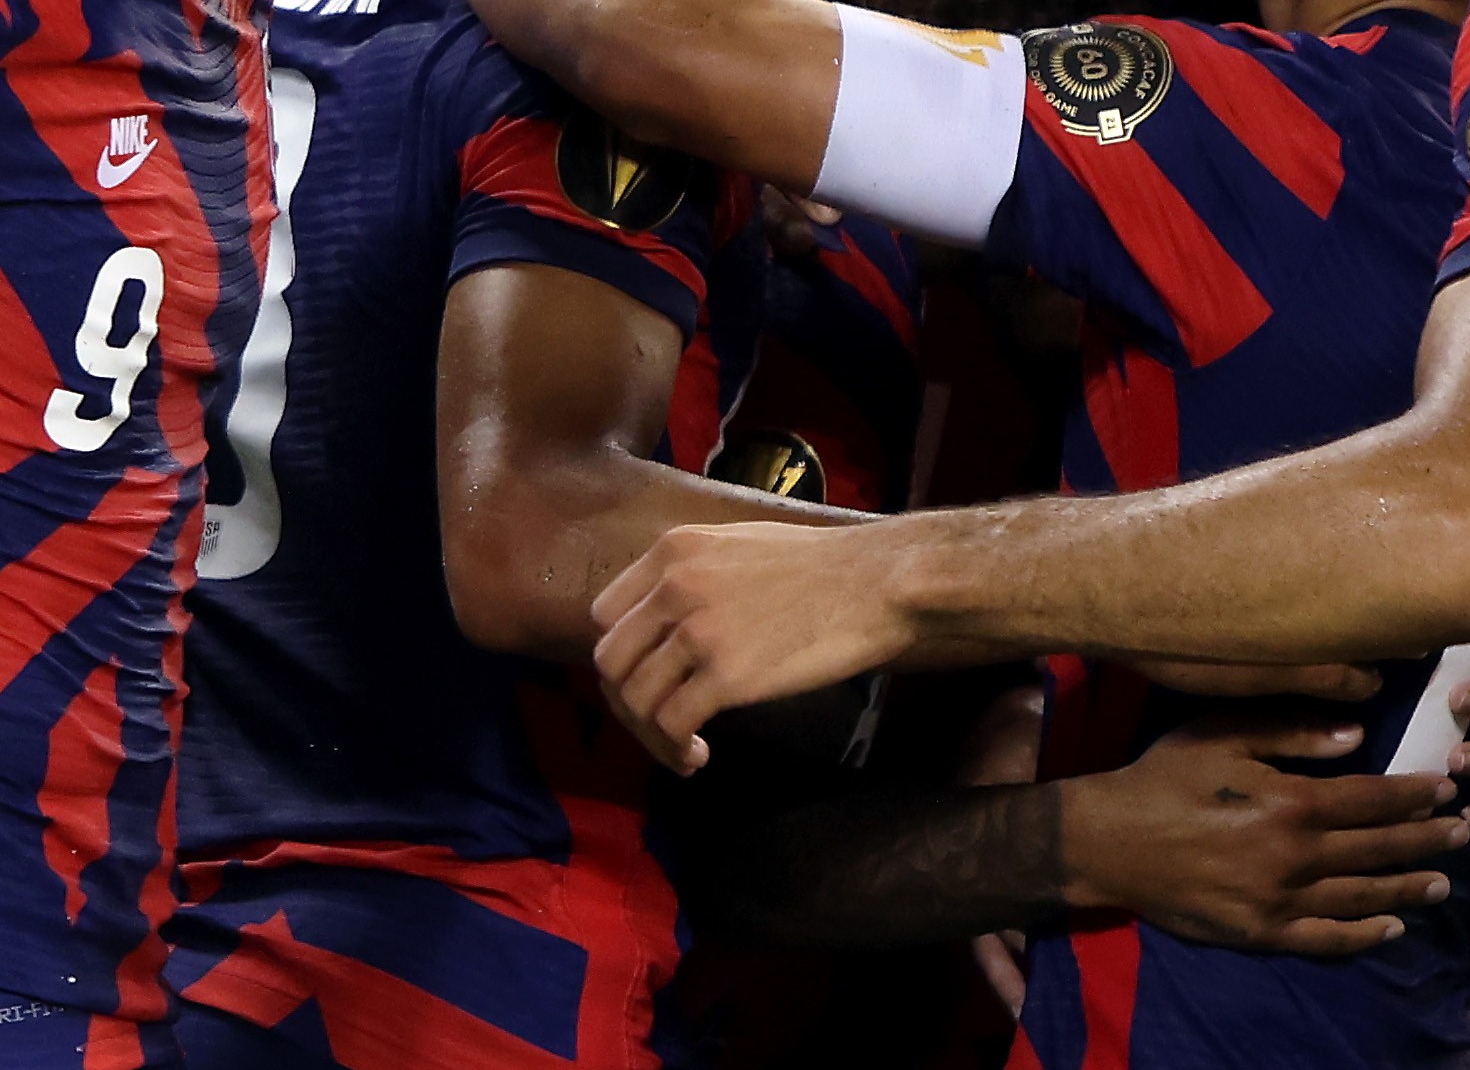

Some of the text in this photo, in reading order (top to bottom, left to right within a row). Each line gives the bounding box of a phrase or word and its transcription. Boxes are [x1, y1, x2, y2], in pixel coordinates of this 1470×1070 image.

[1076, 48, 1109, 80] 60
[1117, 30, 1157, 100] CONCACAF
[1045, 92, 1079, 117] GAME
[109, 114, 149, 156] NIKE
[43, 247, 164, 452] 9
